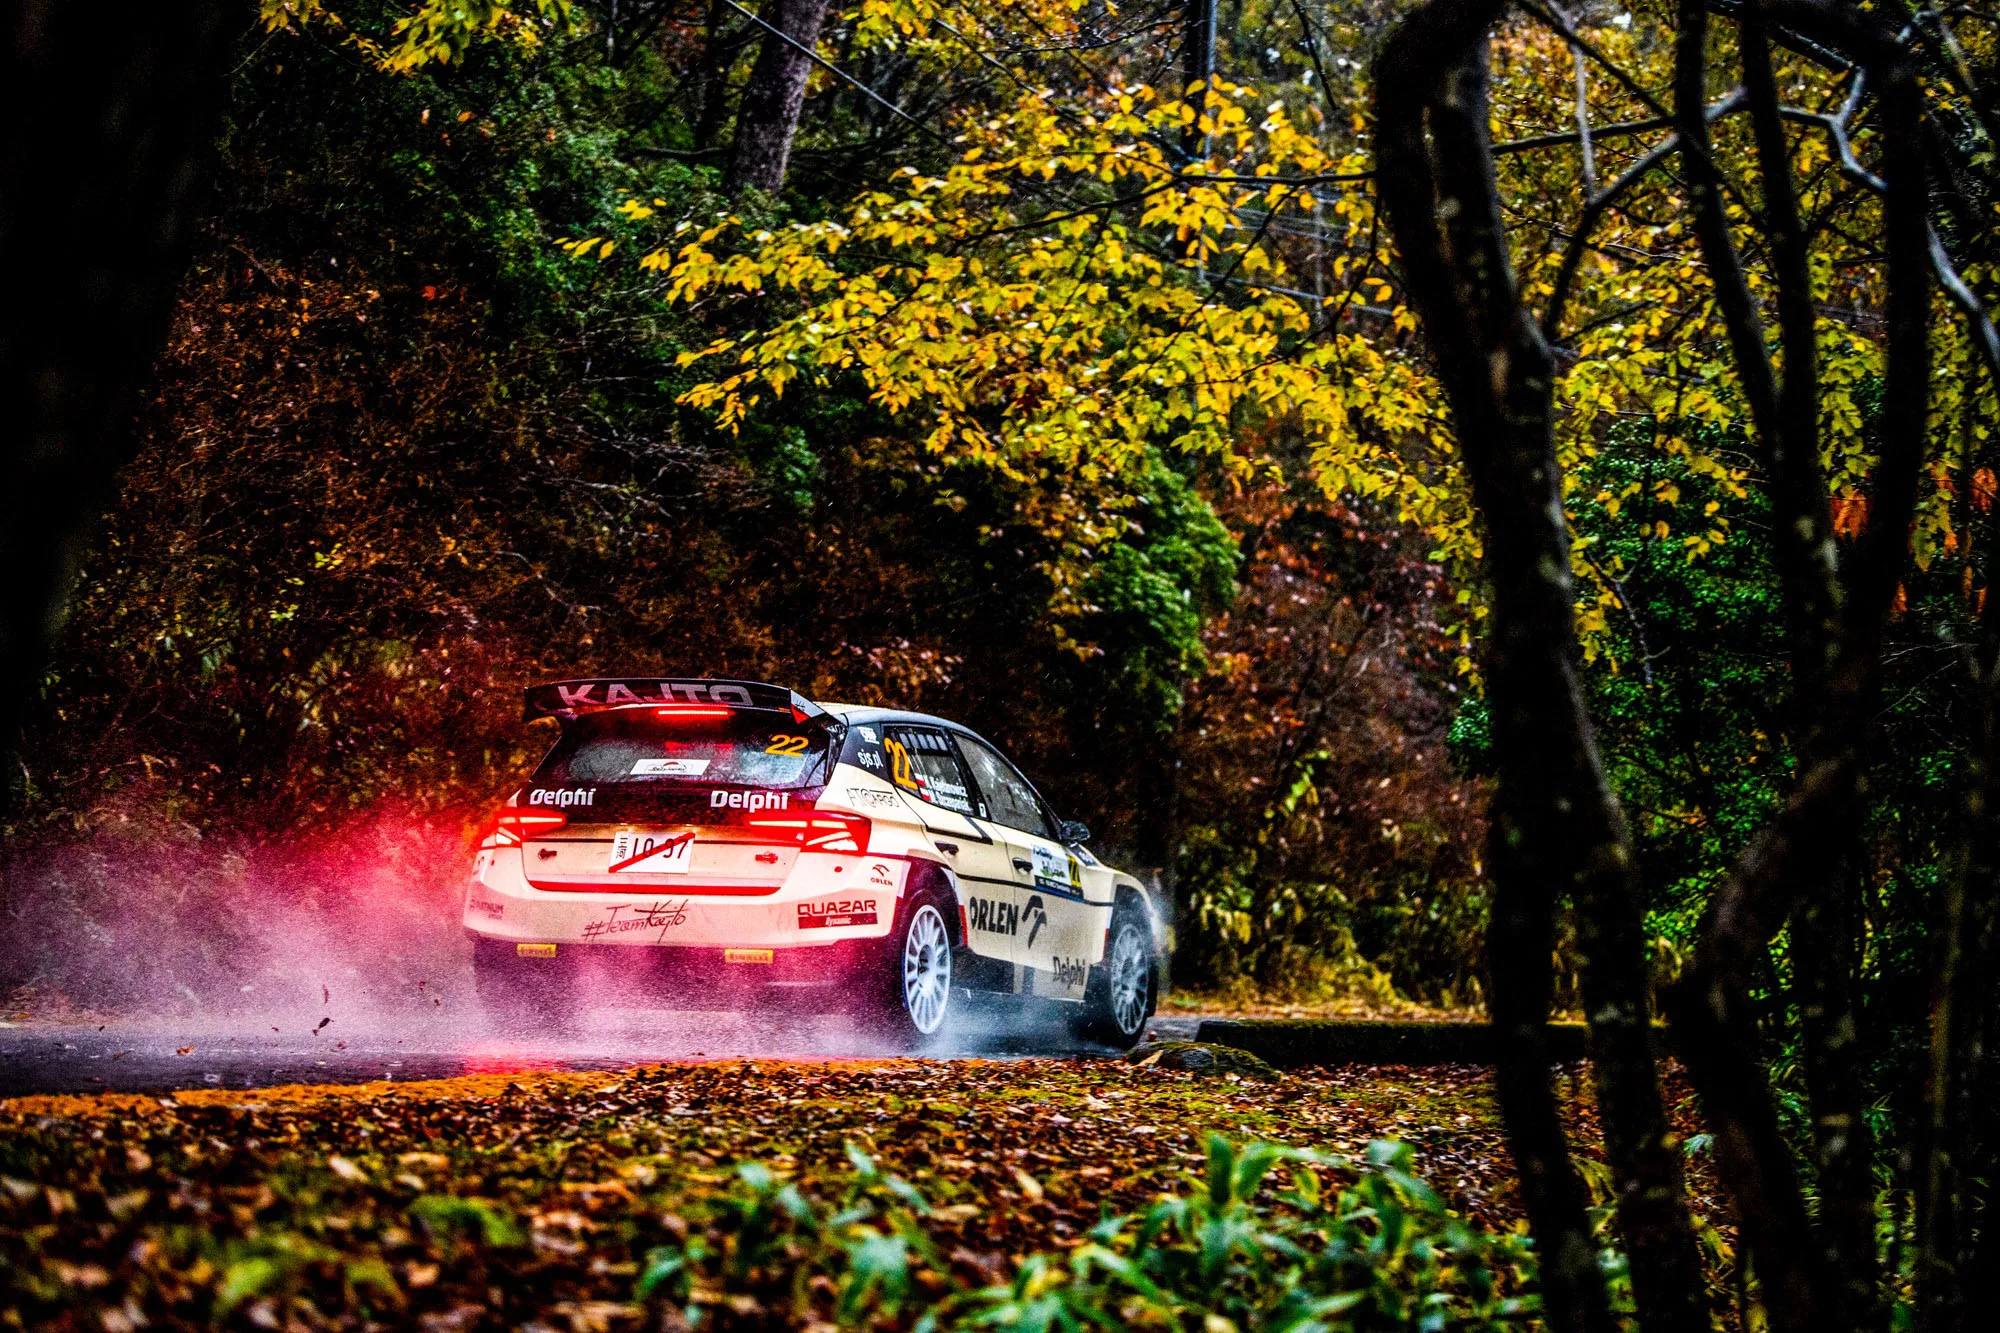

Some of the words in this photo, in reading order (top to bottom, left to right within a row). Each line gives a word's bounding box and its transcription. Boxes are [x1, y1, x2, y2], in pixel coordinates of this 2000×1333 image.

[557, 683, 754, 707] KAJTO
[764, 734, 809, 757] 22
[857, 748, 884, 769] sjs.pl
[883, 737, 919, 790] 22
[529, 788, 597, 808] Delphi
[710, 790, 789, 813] Delphi
[870, 877, 893, 886] ORLEN
[797, 900, 877, 917] QUAZAR
[969, 896, 1019, 936] ORLEN
[1053, 956, 1086, 990] Delphi
